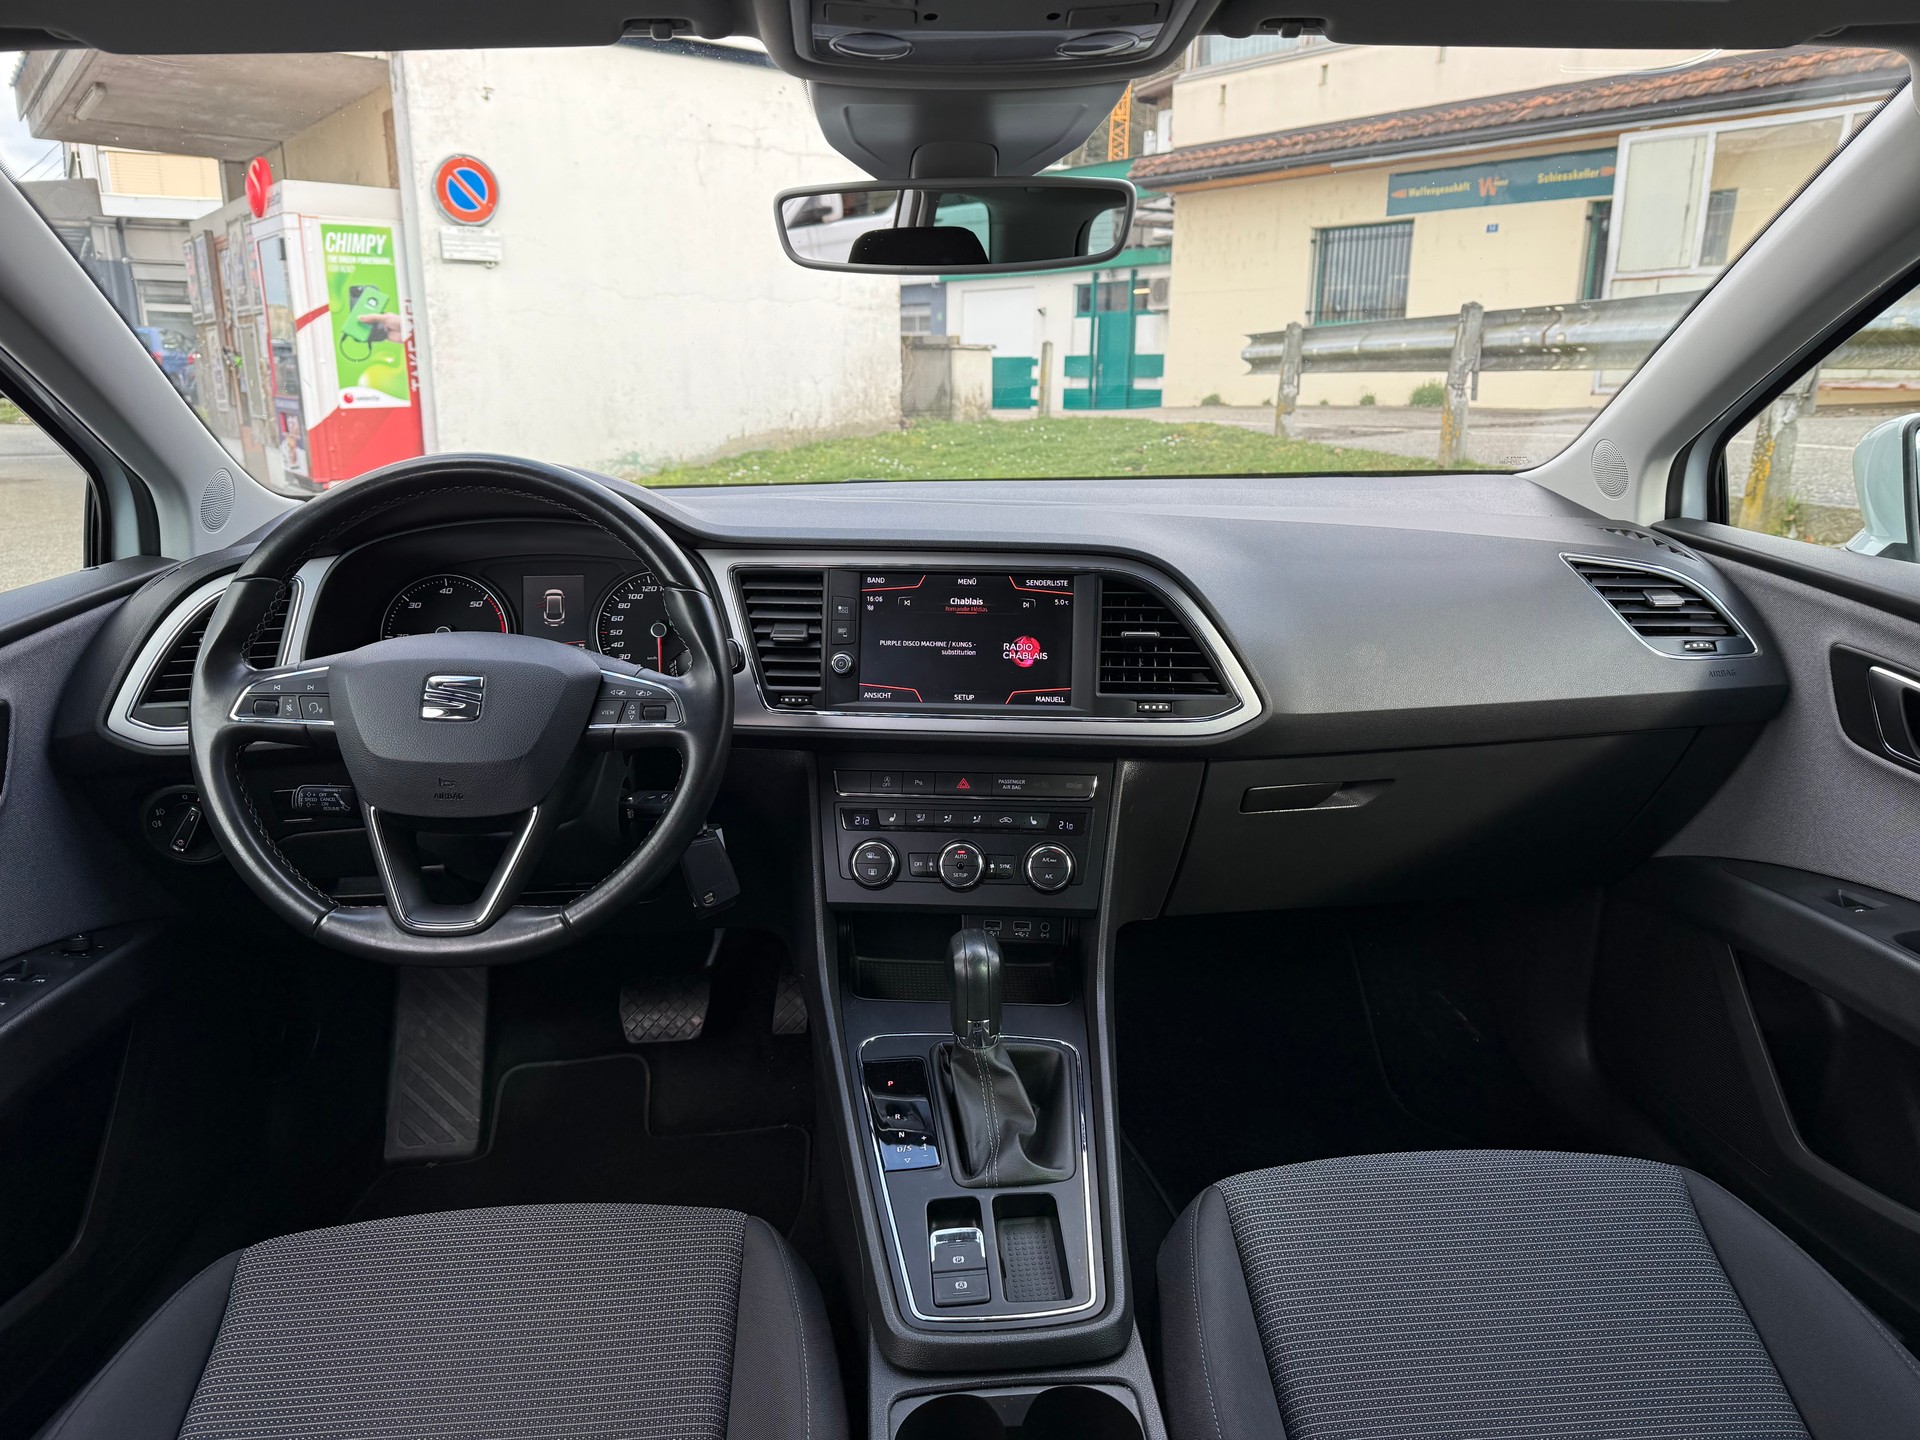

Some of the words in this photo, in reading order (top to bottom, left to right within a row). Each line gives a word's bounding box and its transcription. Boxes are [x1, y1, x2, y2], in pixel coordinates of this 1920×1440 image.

[325, 231, 387, 255] CHIMPY
[957, 577, 977, 585] MENÜ
[1025, 579, 1068, 587] SENDERLISTE
[950, 597, 984, 605] Chablais
[1003, 643, 1033, 651] RADIO
[1003, 651, 1048, 660] CHABLAIS
[1708, 669, 1736, 677] AIRBAG
